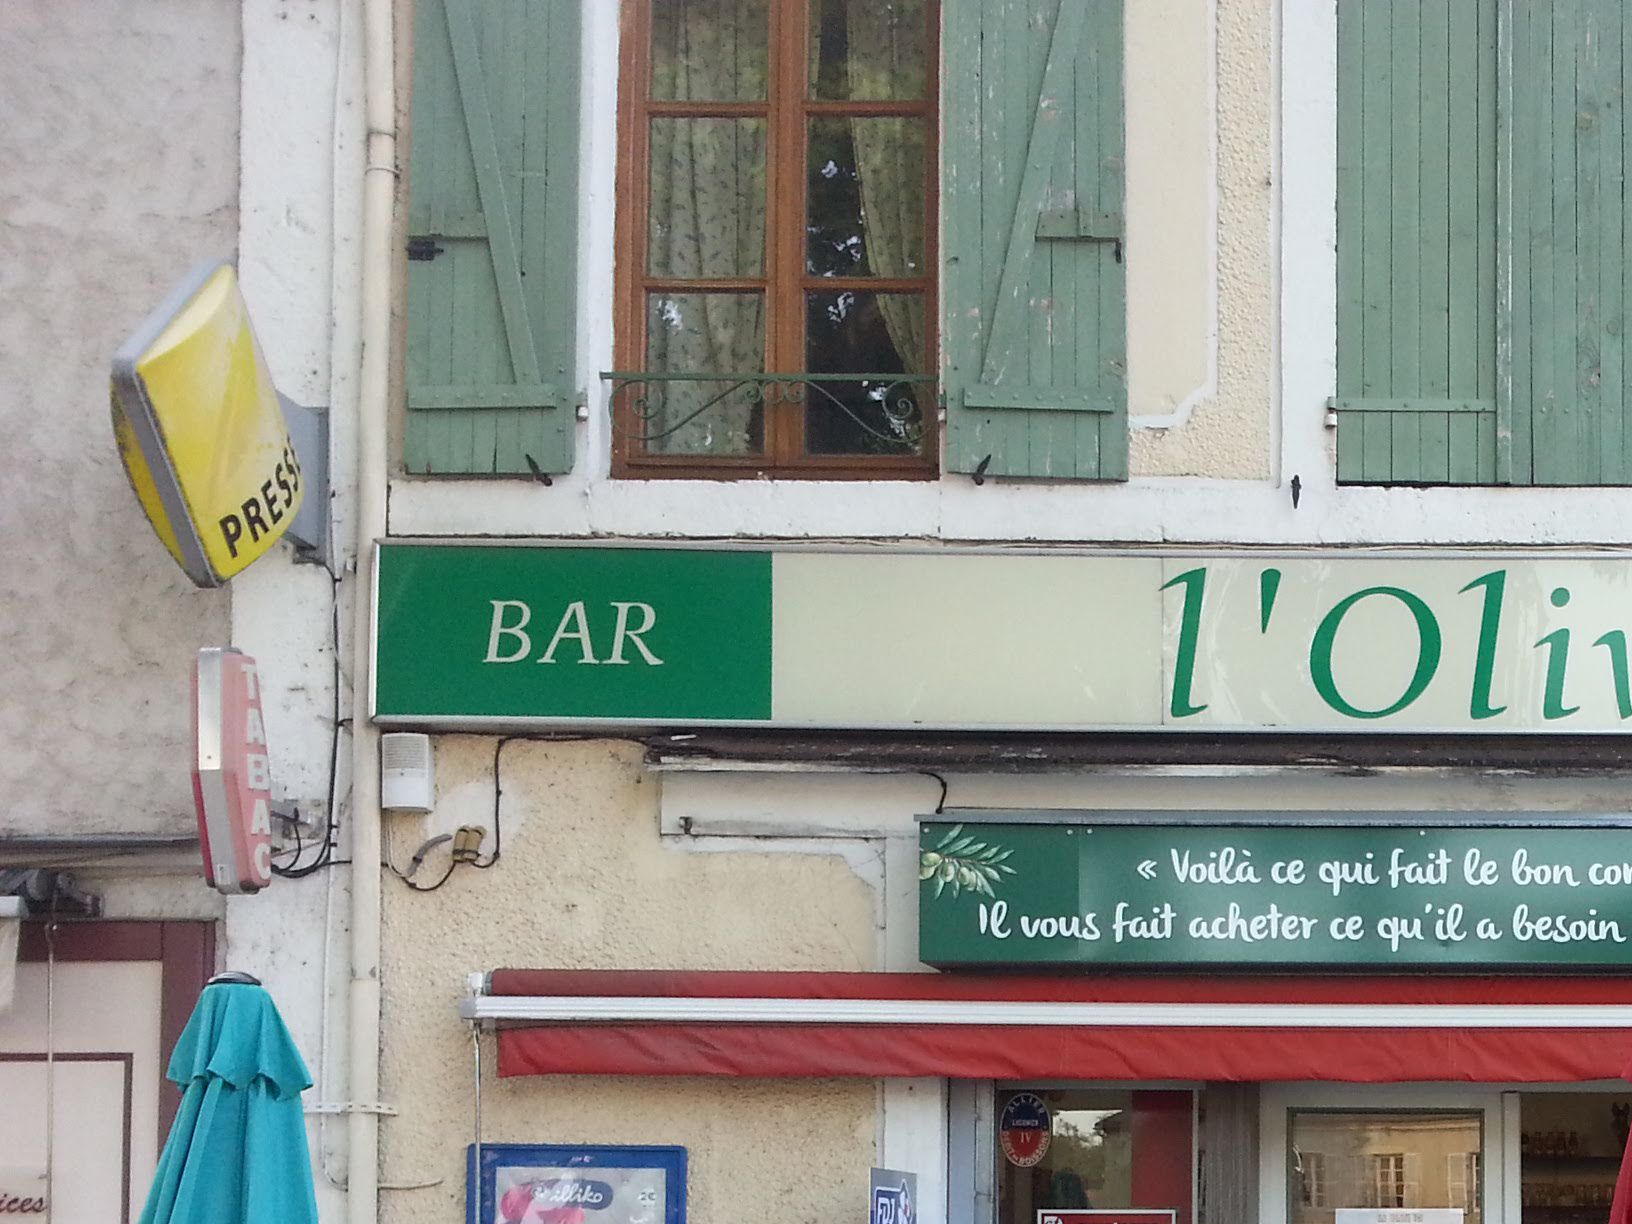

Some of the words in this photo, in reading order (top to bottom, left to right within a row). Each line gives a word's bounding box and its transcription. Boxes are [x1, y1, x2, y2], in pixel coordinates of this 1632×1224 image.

[482, 599, 665, 666] BAR
[240, 664, 272, 879] TABAC
[1171, 847, 1262, 885] Voilà
[1271, 860, 1306, 885] ce
[1318, 853, 1380, 896] qui
[1388, 848, 1453, 889] fait
[1463, 848, 1500, 886] le
[1511, 848, 1581, 887] bon
[978, 900, 1012, 939] Il
[1020, 913, 1102, 940] vous
[1112, 902, 1177, 943] fait
[1188, 902, 1319, 942] acheter
[1329, 916, 1365, 940] ce
[1377, 903, 1467, 952] qu'il
[1476, 918, 1503, 940] a
[1512, 904, 1628, 943] besoin
[1020, 1131, 1032, 1144] IV
